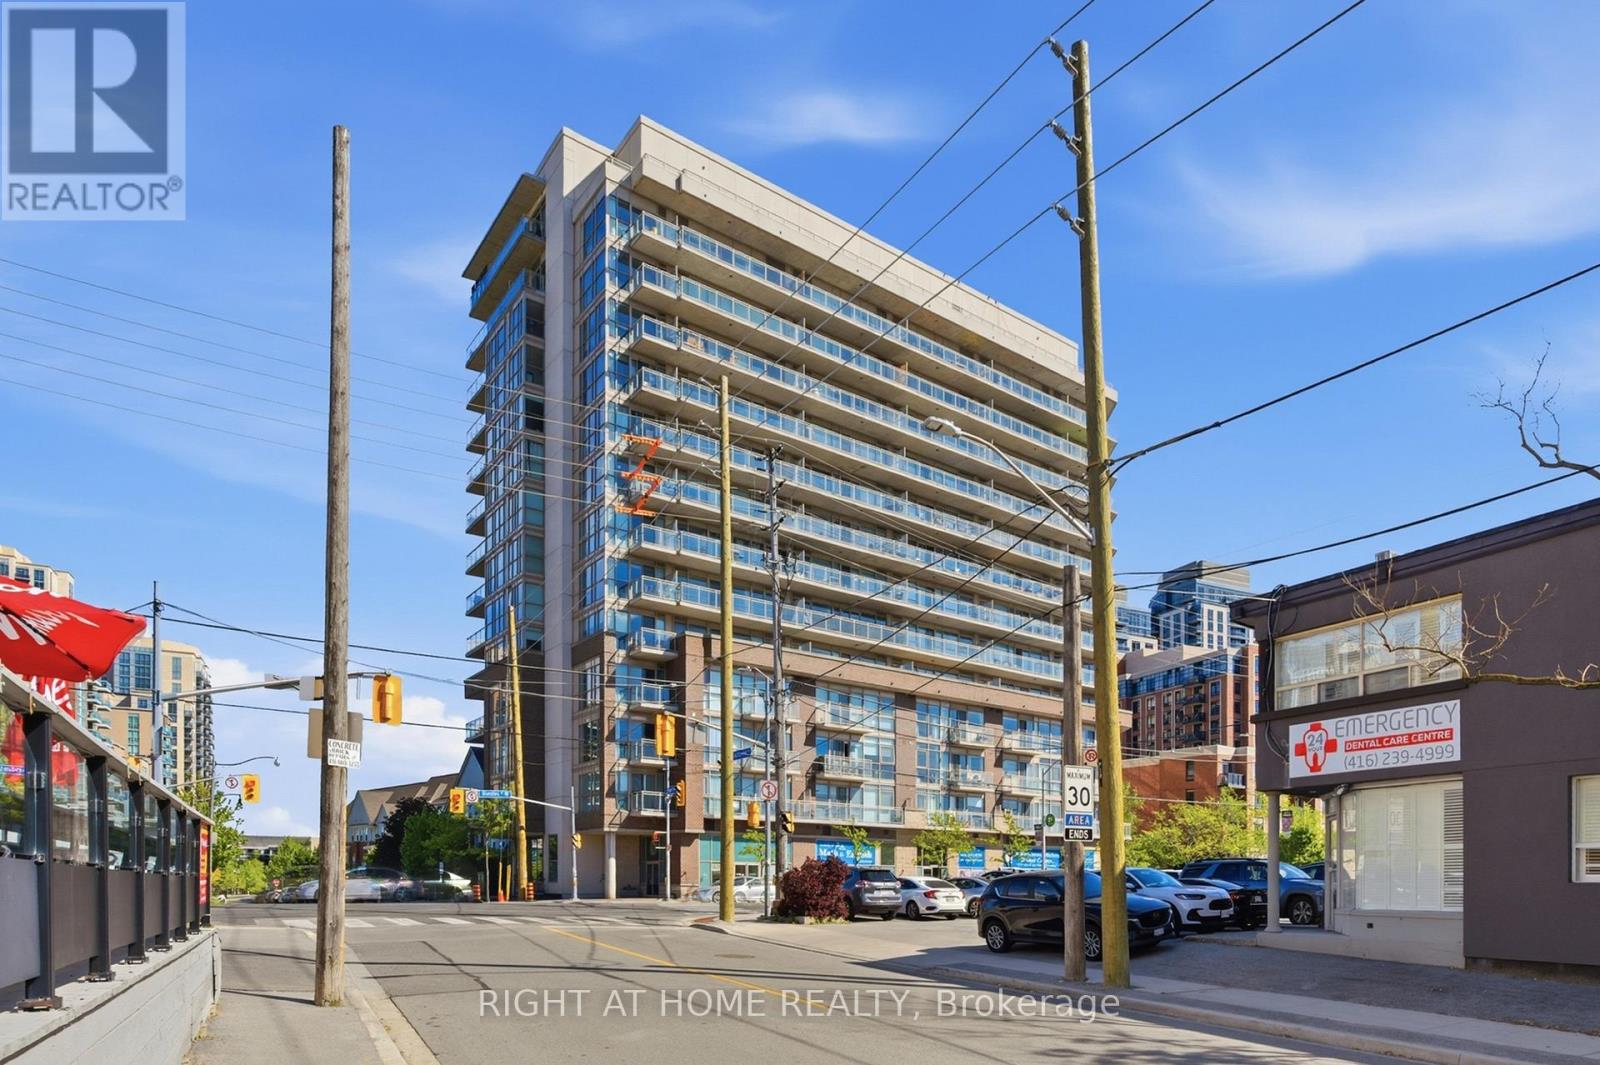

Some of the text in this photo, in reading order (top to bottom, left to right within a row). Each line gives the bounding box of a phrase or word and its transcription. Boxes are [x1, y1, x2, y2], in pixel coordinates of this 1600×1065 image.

[1335, 702, 1458, 738] EMERGENCY
[1307, 732, 1323, 747] 24
[1345, 729, 1452, 750] DENTAL CARE CENTRE
[1344, 744, 1455, 770] (416) 239-4999
[1068, 786, 1091, 806] 30
[1068, 815, 1090, 825] AREA
[1068, 829, 1089, 839] ENDS
